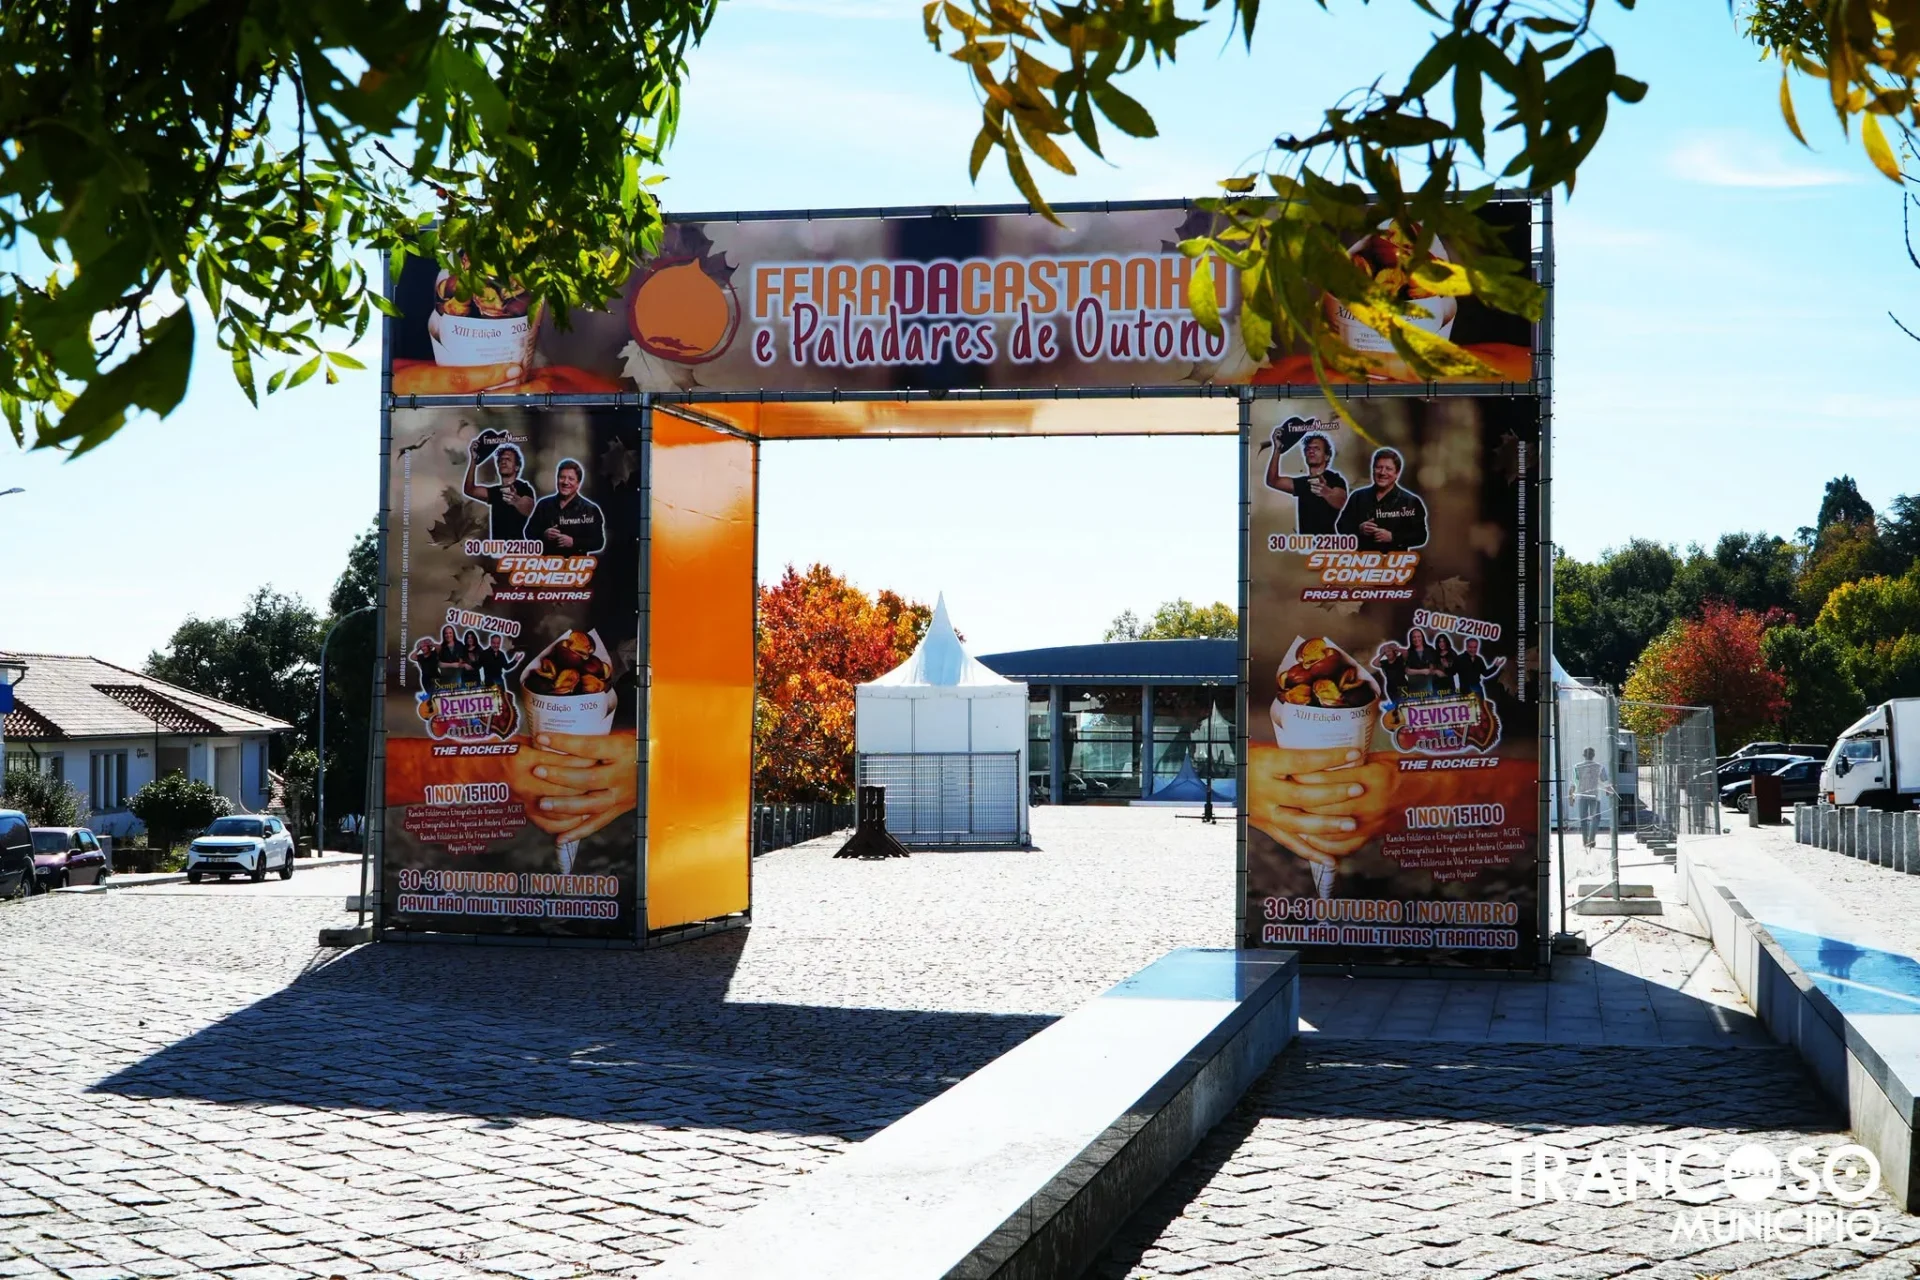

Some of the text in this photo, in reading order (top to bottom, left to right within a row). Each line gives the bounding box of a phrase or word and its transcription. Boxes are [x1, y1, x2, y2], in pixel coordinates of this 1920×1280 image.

[452, 325, 470, 337] XIII
[472, 329, 502, 339] Edição
[756, 298, 1224, 364] e Paladares de Outono
[1288, 420, 1340, 433] Francisco Menezes
[1376, 506, 1416, 519] Herman José
[559, 516, 581, 525] Herman
[466, 541, 542, 554] 30 OUT 22H00
[1270, 536, 1357, 550] 30 OUT 22H00
[500, 558, 596, 571] STAND UP
[1308, 554, 1417, 568] STAND UP
[511, 572, 591, 585] COMEDY
[1323, 569, 1412, 582] COMEDY
[527, 592, 535, 600] &
[537, 591, 592, 600] CONTRAS
[1303, 585, 1413, 600] PRÓS & CONTRAS
[447, 609, 520, 636] 31 OUT 22H00
[1415, 610, 1500, 640] 31 OUT 22H00
[1400, 686, 1434, 702] Sempre
[1437, 689, 1451, 700] que
[440, 696, 494, 716] REVISTA
[546, 702, 572, 713] Edição
[579, 702, 598, 711] 2026
[1293, 708, 1371, 723] XIII Edição 2026
[1407, 705, 1470, 728] REVISTA
[433, 744, 518, 756] THE ROCKETS
[1400, 757, 1499, 770] THE ROCKETS
[426, 784, 507, 804] 1 NOV 15H00
[1407, 805, 1503, 827] 1 NOV 15H00
[1503, 828, 1521, 837] ACRT
[1383, 847, 1401, 859] Grupo
[1456, 869, 1478, 882] Popular
[443, 871, 517, 893] OUTUBRO
[521, 874, 527, 893] 1
[531, 874, 618, 896] NOVEMBRO
[399, 893, 617, 918] PAVILHÃO MULTIUSOS TRANCOSO
[1315, 900, 1401, 922] OUTUBRO
[1405, 901, 1413, 922] 1
[1419, 901, 1517, 925] NOVEMBRO
[1264, 924, 1517, 948] PAVILHÃO MULTIUSOS TRANCOSO
